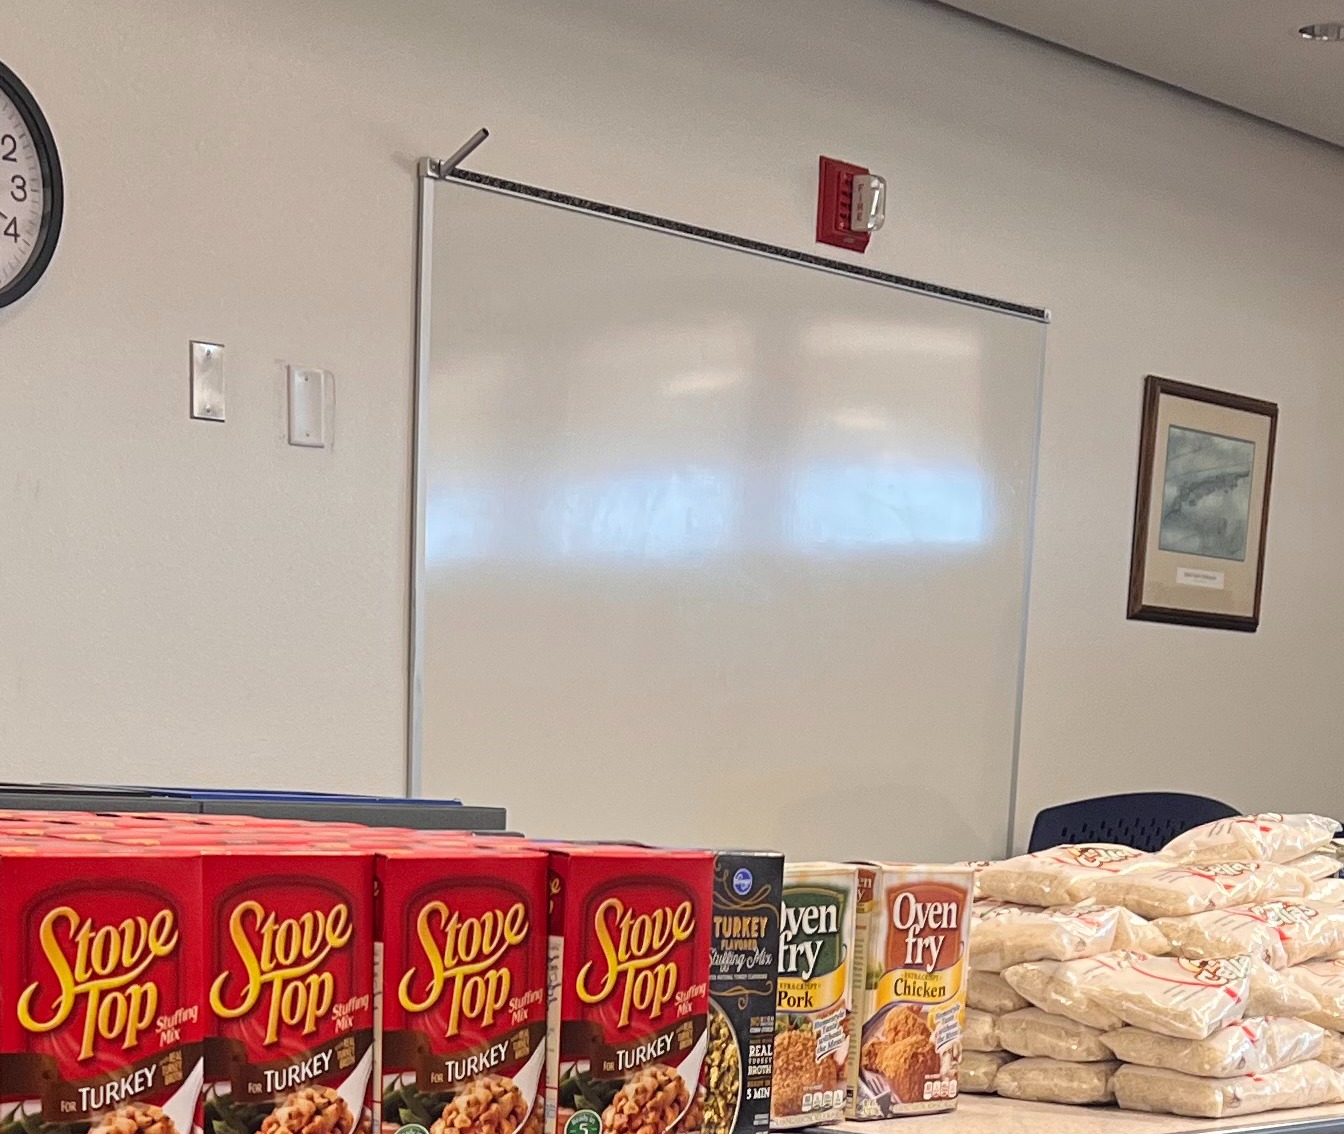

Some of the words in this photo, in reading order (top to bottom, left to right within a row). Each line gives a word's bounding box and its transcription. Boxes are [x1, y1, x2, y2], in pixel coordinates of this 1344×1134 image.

[1, 134, 17, 163] 2
[10, 174, 27, 202] 3
[3, 216, 21, 244] 4
[893, 892, 957, 931] Oven
[713, 915, 768, 938] TURKEY
[210, 900, 353, 1018] Stove
[398, 901, 530, 1013] Stove
[576, 897, 696, 1003] Stove
[905, 924, 945, 973] fry
[17, 906, 179, 1032] Stove
[444, 966, 511, 1038] Top
[508, 988, 544, 1014] Stuffing
[616, 961, 678, 1030] Top
[674, 982, 707, 1008] Stuffing
[778, 990, 813, 1008] Pork
[894, 977, 946, 998] Chicken
[76, 980, 158, 1062] Top
[156, 1004, 198, 1033] Stuffing
[261, 970, 334, 1046] Top
[331, 994, 369, 1022] Stuffing
[511, 1005, 529, 1026] Mix
[676, 1000, 693, 1018] Mix
[160, 1027, 180, 1048] Mix
[335, 1014, 354, 1034] Mix
[445, 1041, 509, 1082] TURKEY
[617, 1032, 674, 1072] TURKEY
[749, 1044, 773, 1057] REAL
[264, 1049, 333, 1093] TURKEY
[78, 1064, 157, 1112] TURKEY
